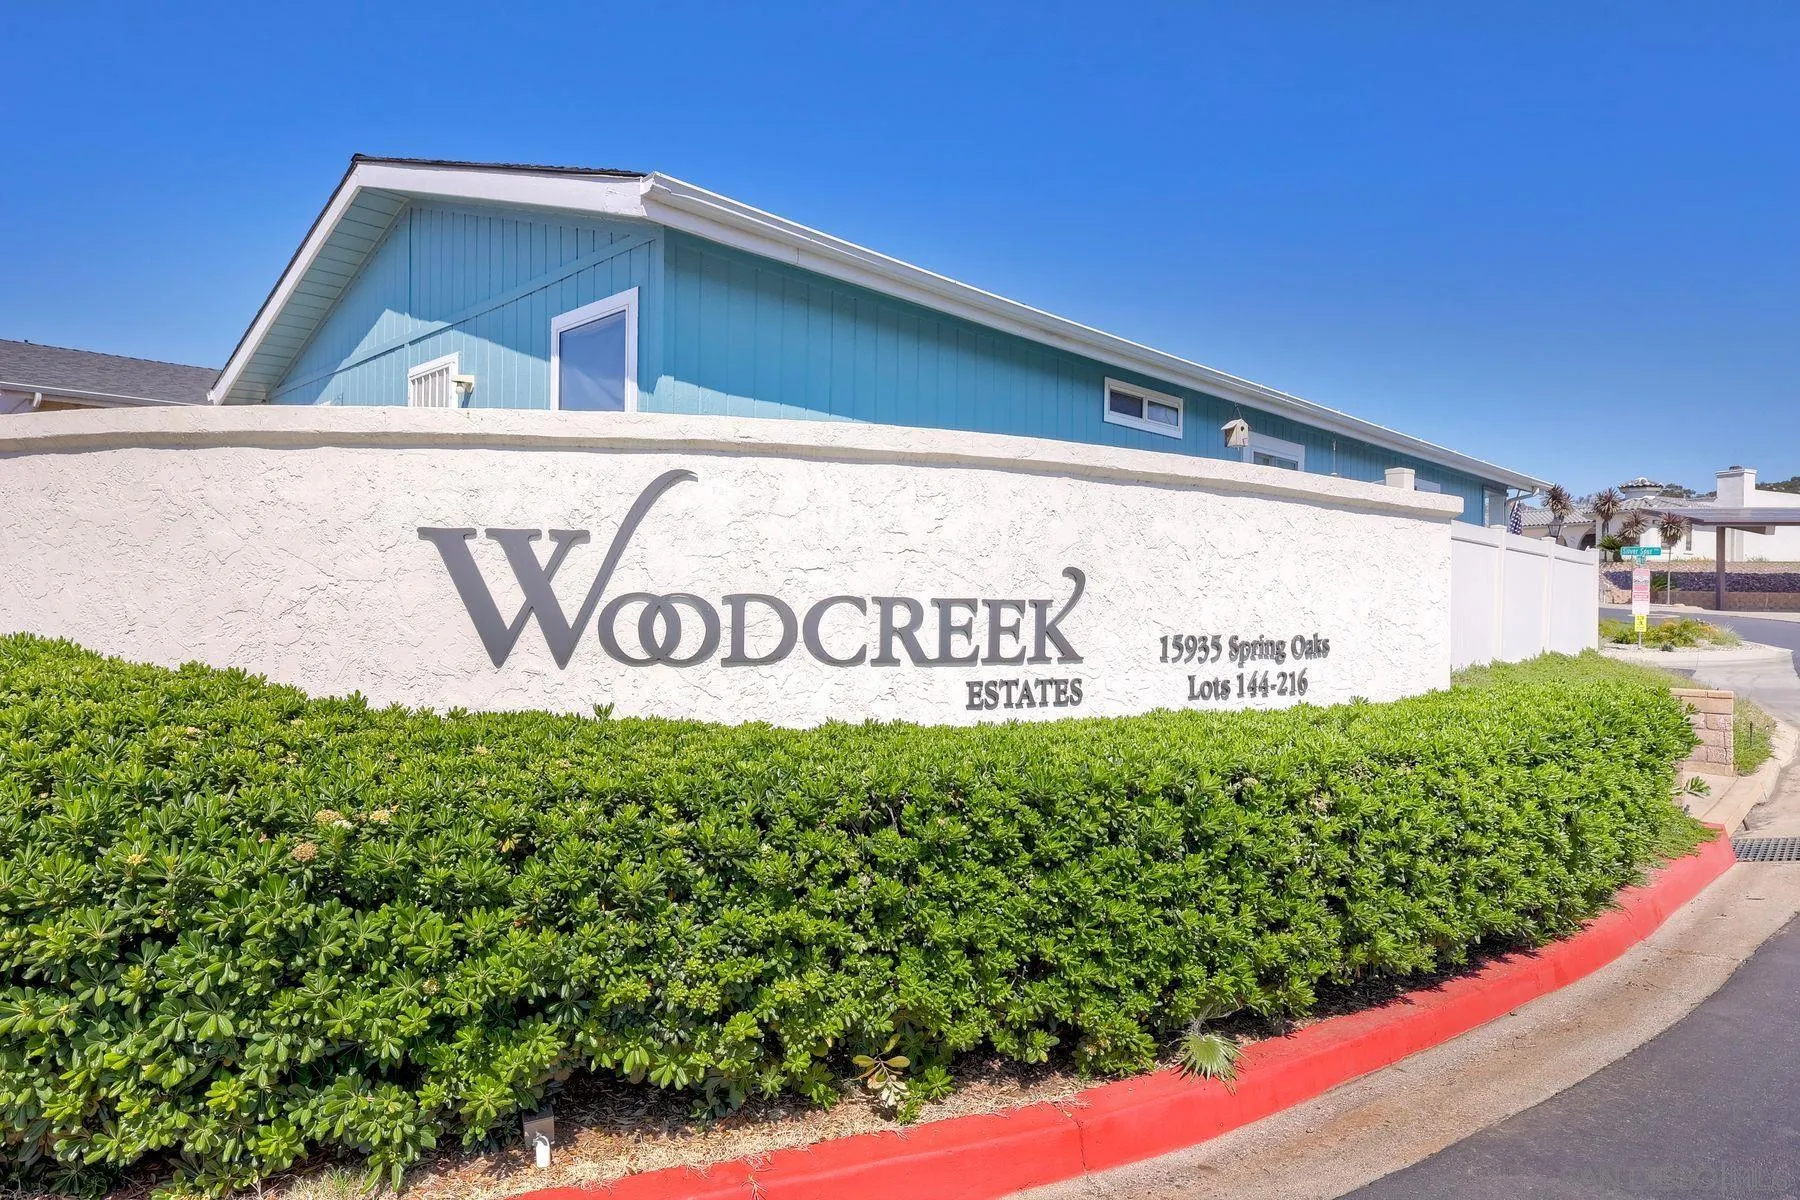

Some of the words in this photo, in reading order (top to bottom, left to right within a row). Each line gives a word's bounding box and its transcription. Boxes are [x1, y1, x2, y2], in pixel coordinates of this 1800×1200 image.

[417, 469, 1086, 670] WOODCREEK
[1159, 634, 1223, 663] 15935
[1228, 634, 1287, 668] Spring
[1290, 633, 1331, 659] Oaks
[965, 678, 1083, 711] ESTATES
[1187, 674, 1231, 701] Lots
[1236, 668, 1309, 698] 144-216
